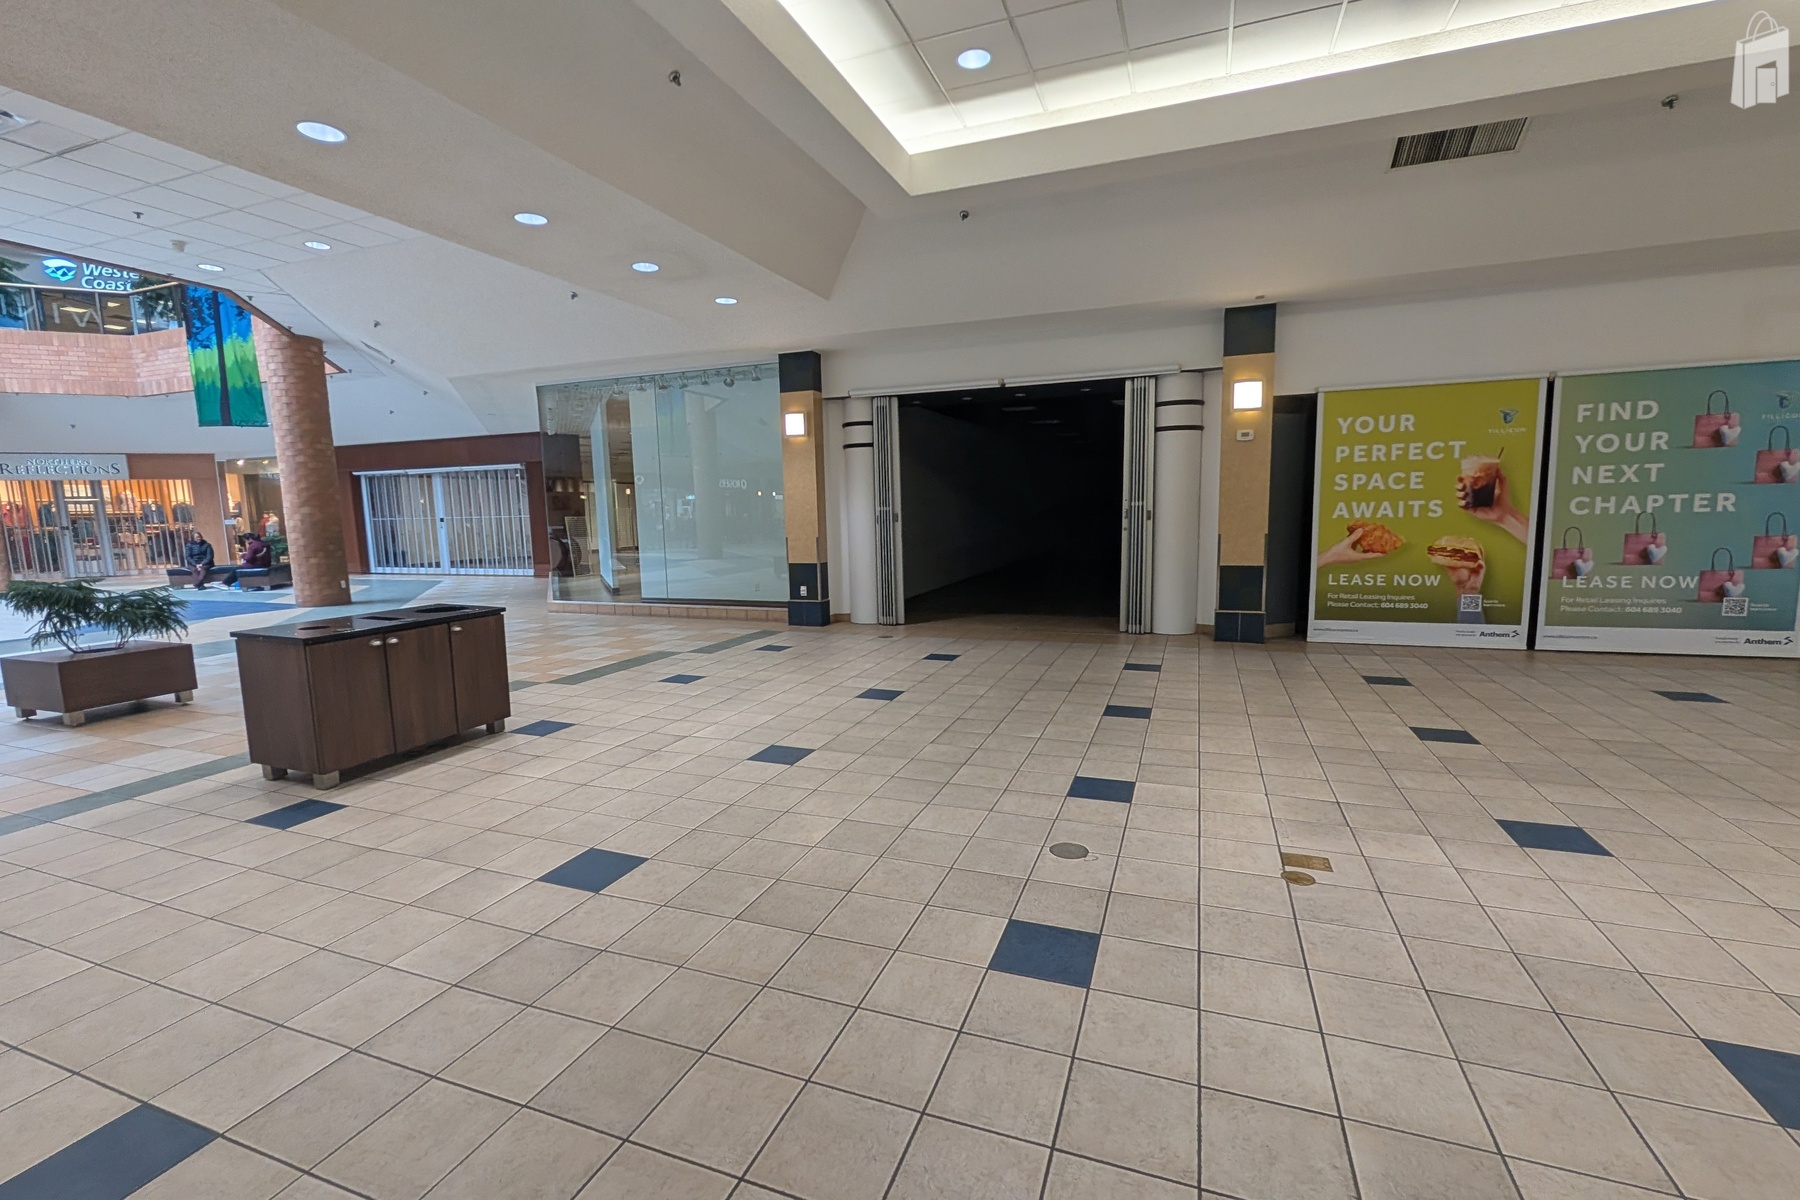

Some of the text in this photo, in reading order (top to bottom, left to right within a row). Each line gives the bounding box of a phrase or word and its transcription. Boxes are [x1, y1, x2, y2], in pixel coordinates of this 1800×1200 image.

[81, 276, 132, 291] Coast
[1577, 400, 1659, 423] FIND
[1337, 414, 1416, 435] YOUR
[1335, 441, 1466, 463] PERFECT
[1575, 431, 1670, 454] YOUR
[0, 463, 120, 475] REFLECTIONS
[1572, 463, 1665, 485] NEXT
[1333, 471, 1425, 491] SPACE
[1332, 500, 1443, 519] AWAITS
[1569, 492, 1736, 515] CHAPTER
[1328, 573, 1441, 587] LEASE NOW
[1562, 575, 1699, 589] LEASE NOW
[1327, 600, 1350, 608] Please
[1380, 601, 1395, 609] 604
[1339, 592, 1359, 600] Retail
[1575, 596, 1599, 604] Retail
[1599, 597, 1632, 605] Leasing
